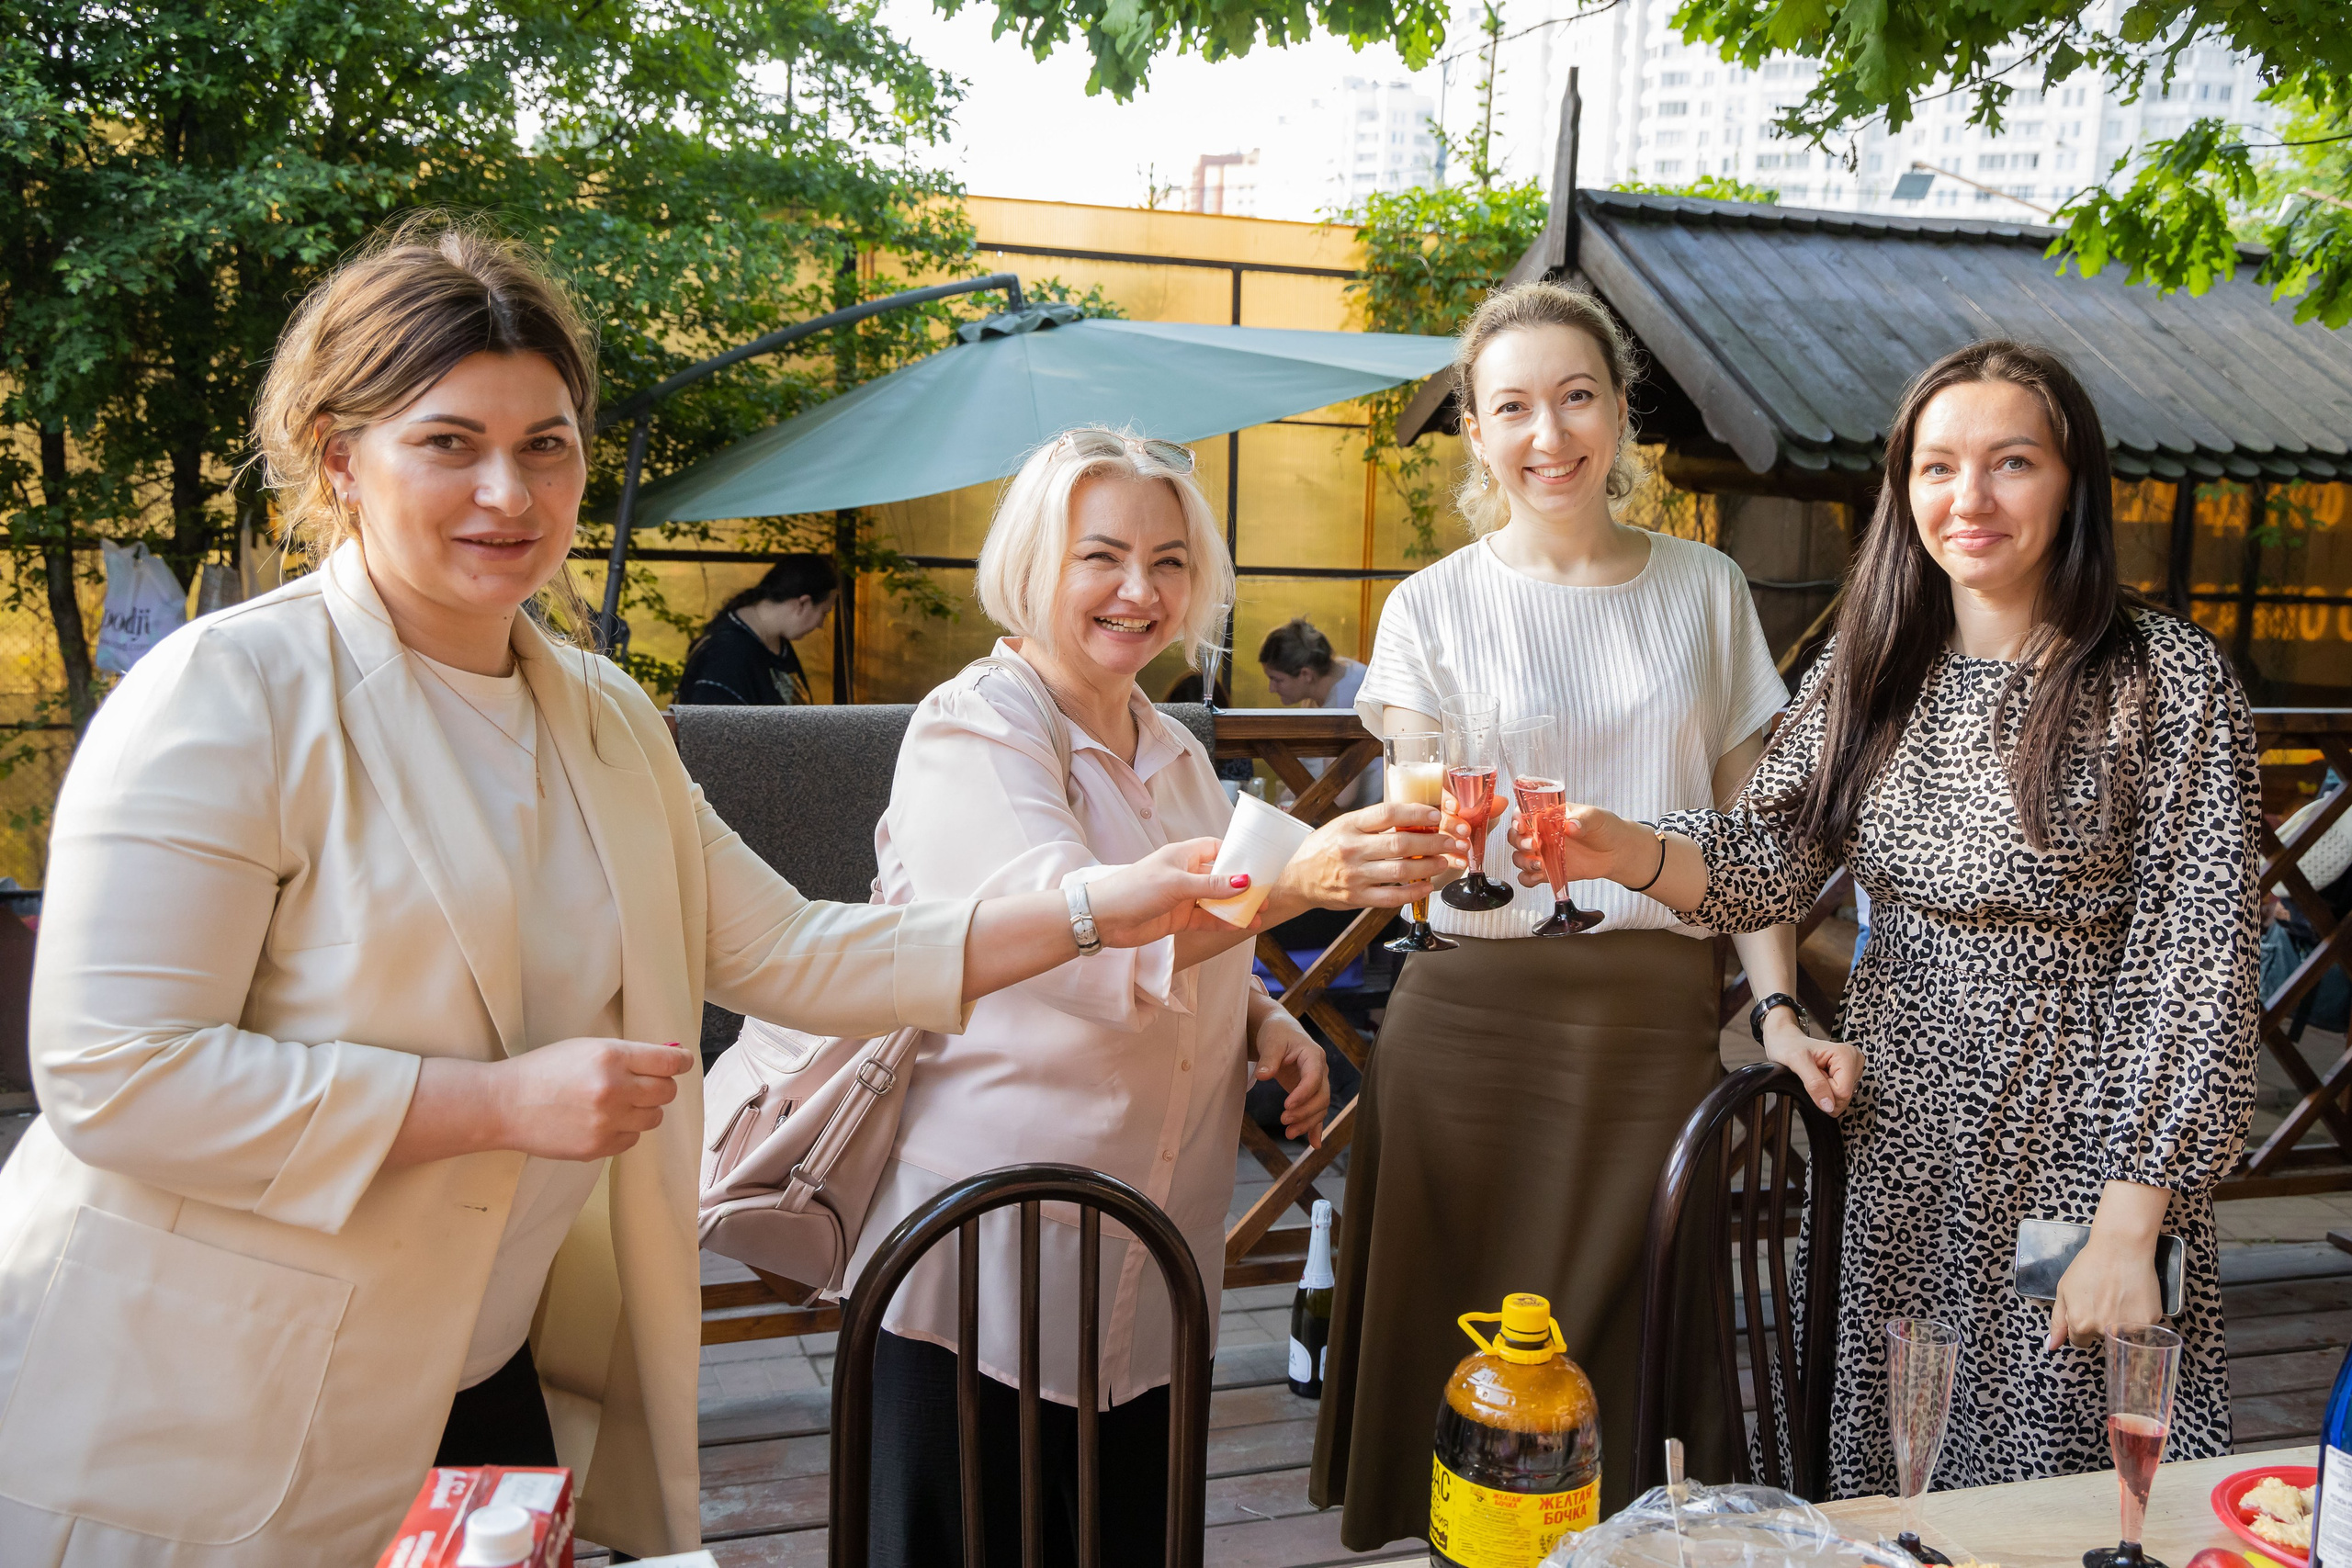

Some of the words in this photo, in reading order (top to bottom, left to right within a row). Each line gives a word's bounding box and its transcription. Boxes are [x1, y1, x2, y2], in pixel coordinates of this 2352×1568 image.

[1431, 1463, 1451, 1502] АС
[1538, 1486, 1592, 1511] ЖЕЛТАЯ
[1544, 1504, 1587, 1525] БОЧКА
